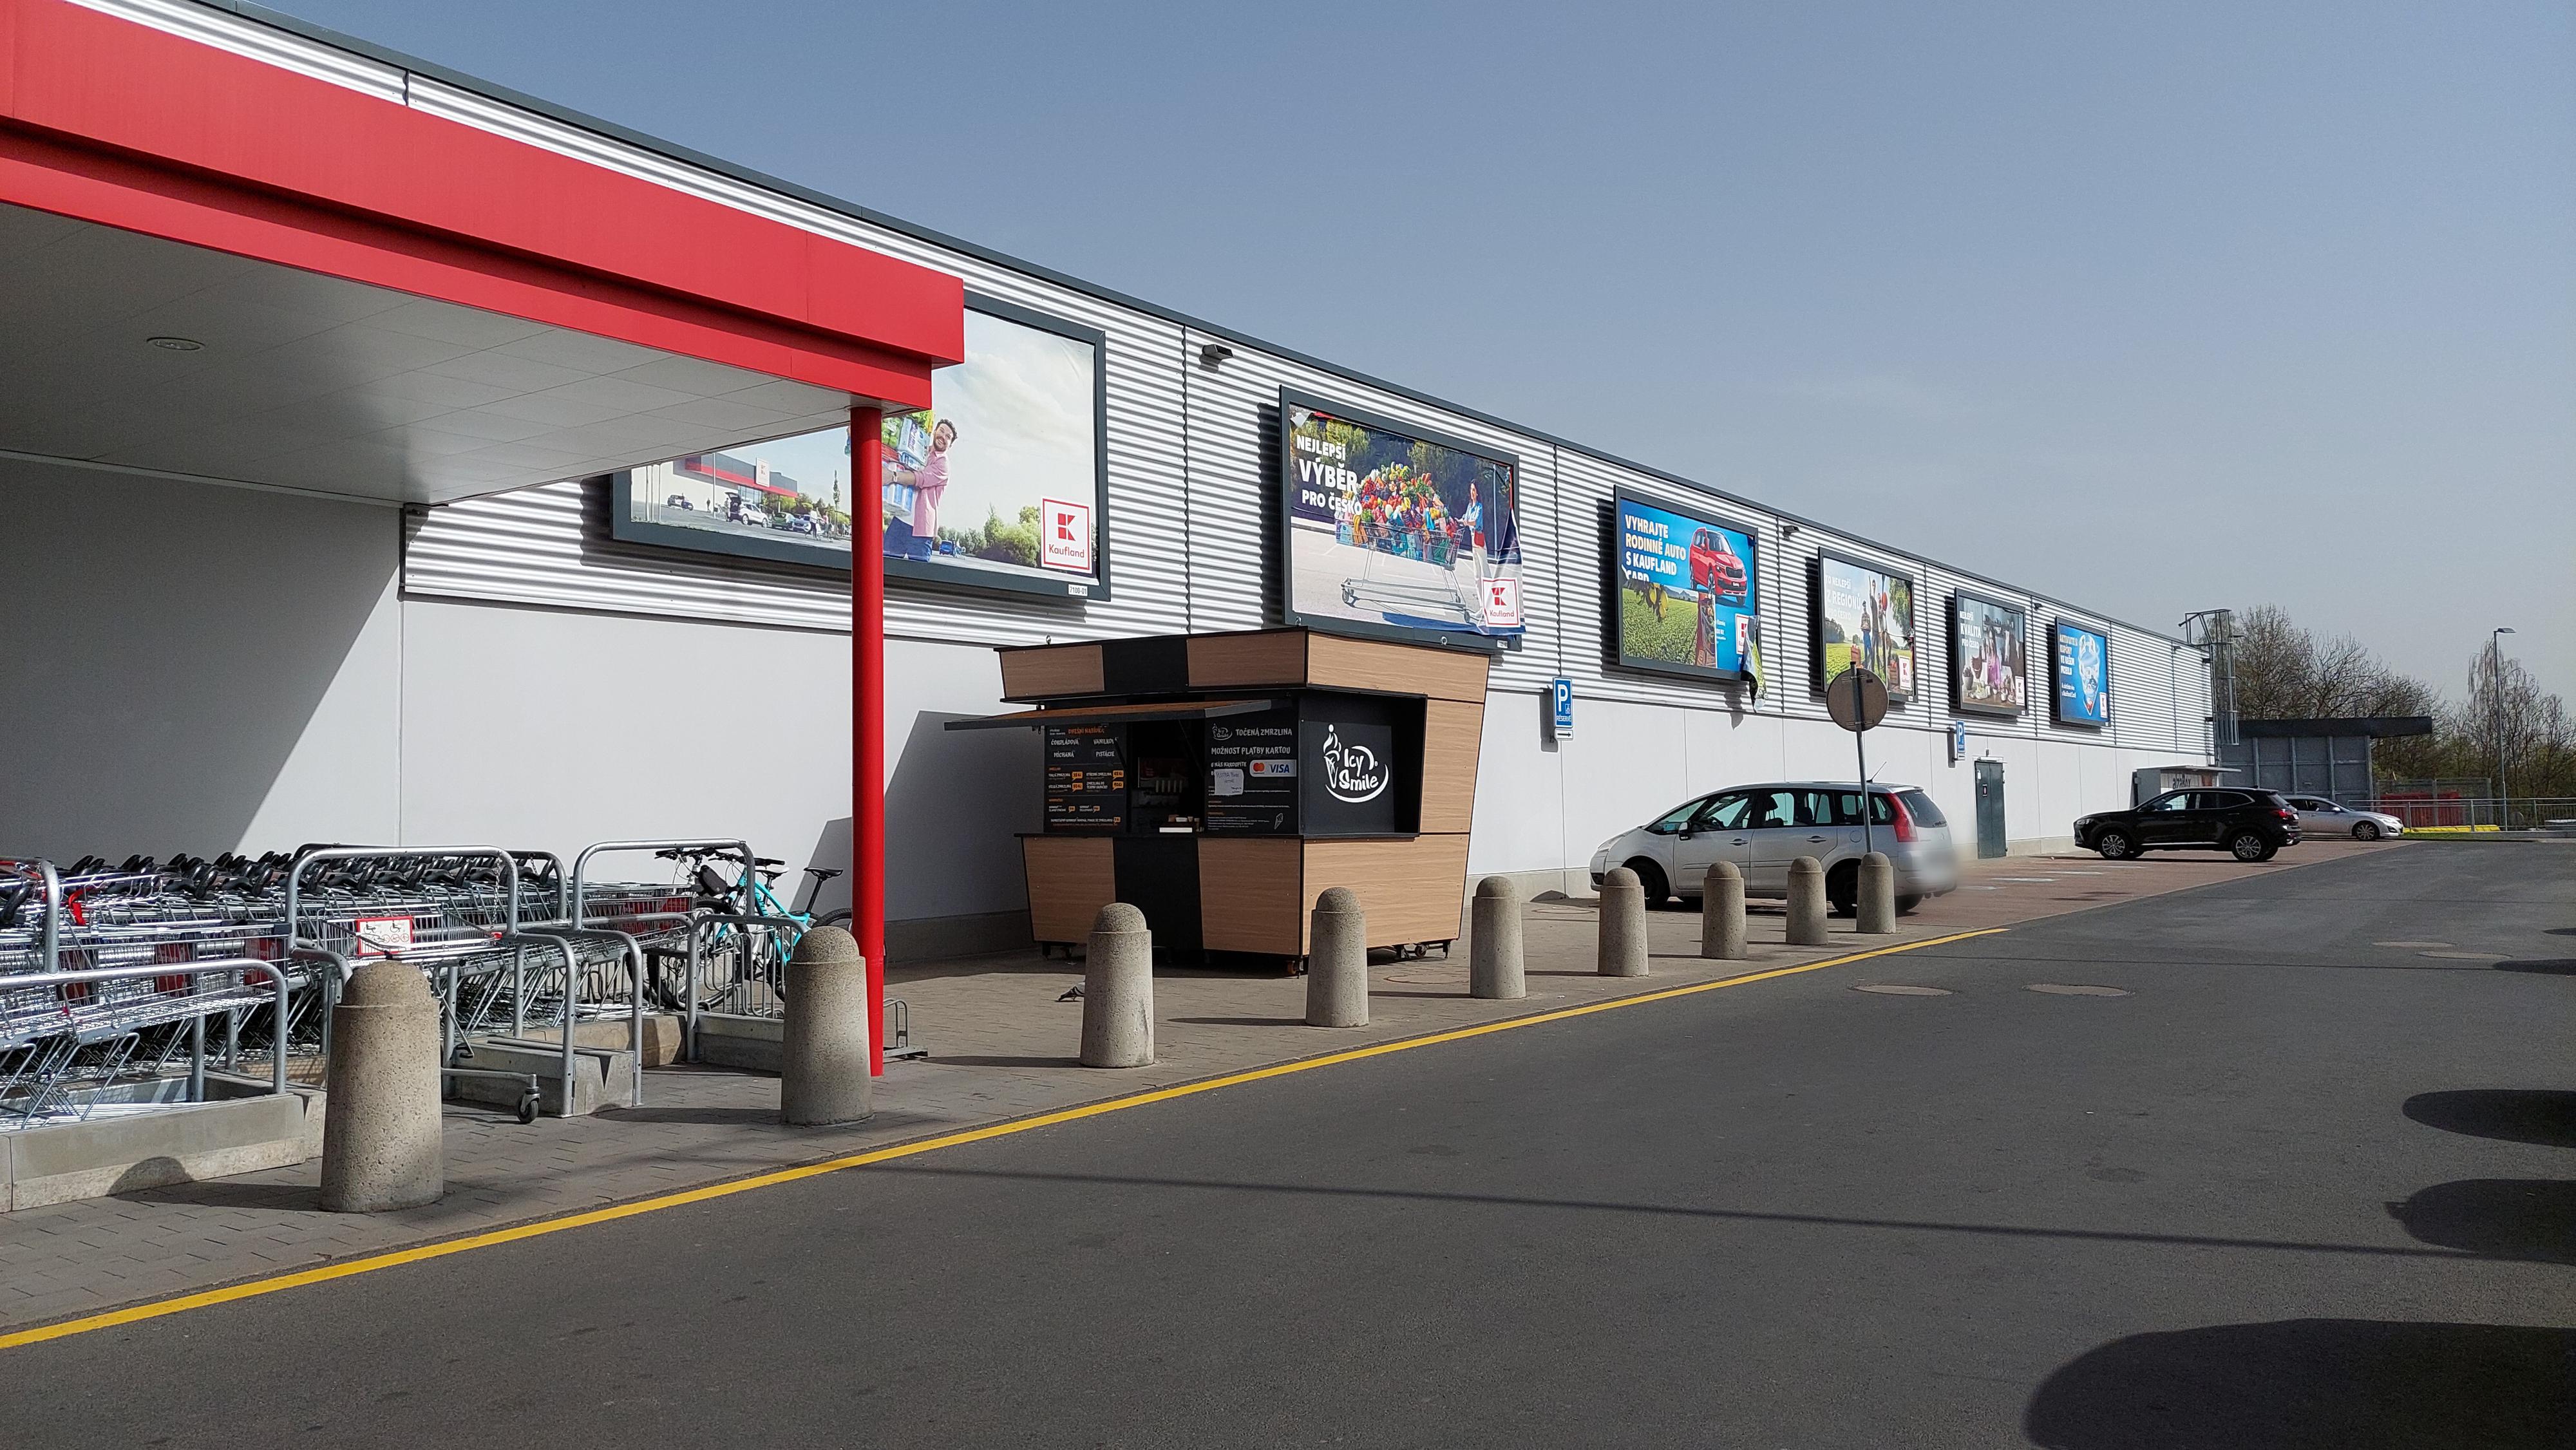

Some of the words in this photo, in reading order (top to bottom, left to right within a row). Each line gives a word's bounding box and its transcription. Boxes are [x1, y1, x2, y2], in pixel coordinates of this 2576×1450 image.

[1296, 435, 1346, 460] NEJLEPŠÍ
[1299, 457, 1358, 494] VÝBĚR
[1302, 489, 1325, 507] PRO
[1328, 492, 1363, 515] ČESKO
[1625, 514, 1669, 539] VYHRAJTE
[1048, 544, 1085, 558] Kaufland
[1625, 533, 1663, 555] RODINNÉ
[1664, 543, 1686, 561] AUTO
[1626, 551, 1631, 566] S
[1633, 553, 1677, 576] KAUFLAND
[1832, 590, 1861, 610] REGIONŮ
[1960, 623, 1982, 639] KVALITA
[1557, 684, 1568, 712] P
[1235, 728, 1260, 737] TOČENÁ
[1260, 728, 1293, 736] ZMRZLINA
[1958, 724, 1963, 742] P
[1211, 746, 1240, 755] MOŽNOST
[1241, 746, 1264, 755] PLATBY
[1265, 746, 1291, 755] KARTOU
[1269, 764, 1290, 773] VISA
[1344, 748, 1364, 777] Icy
[1339, 769, 1379, 791] Smile
